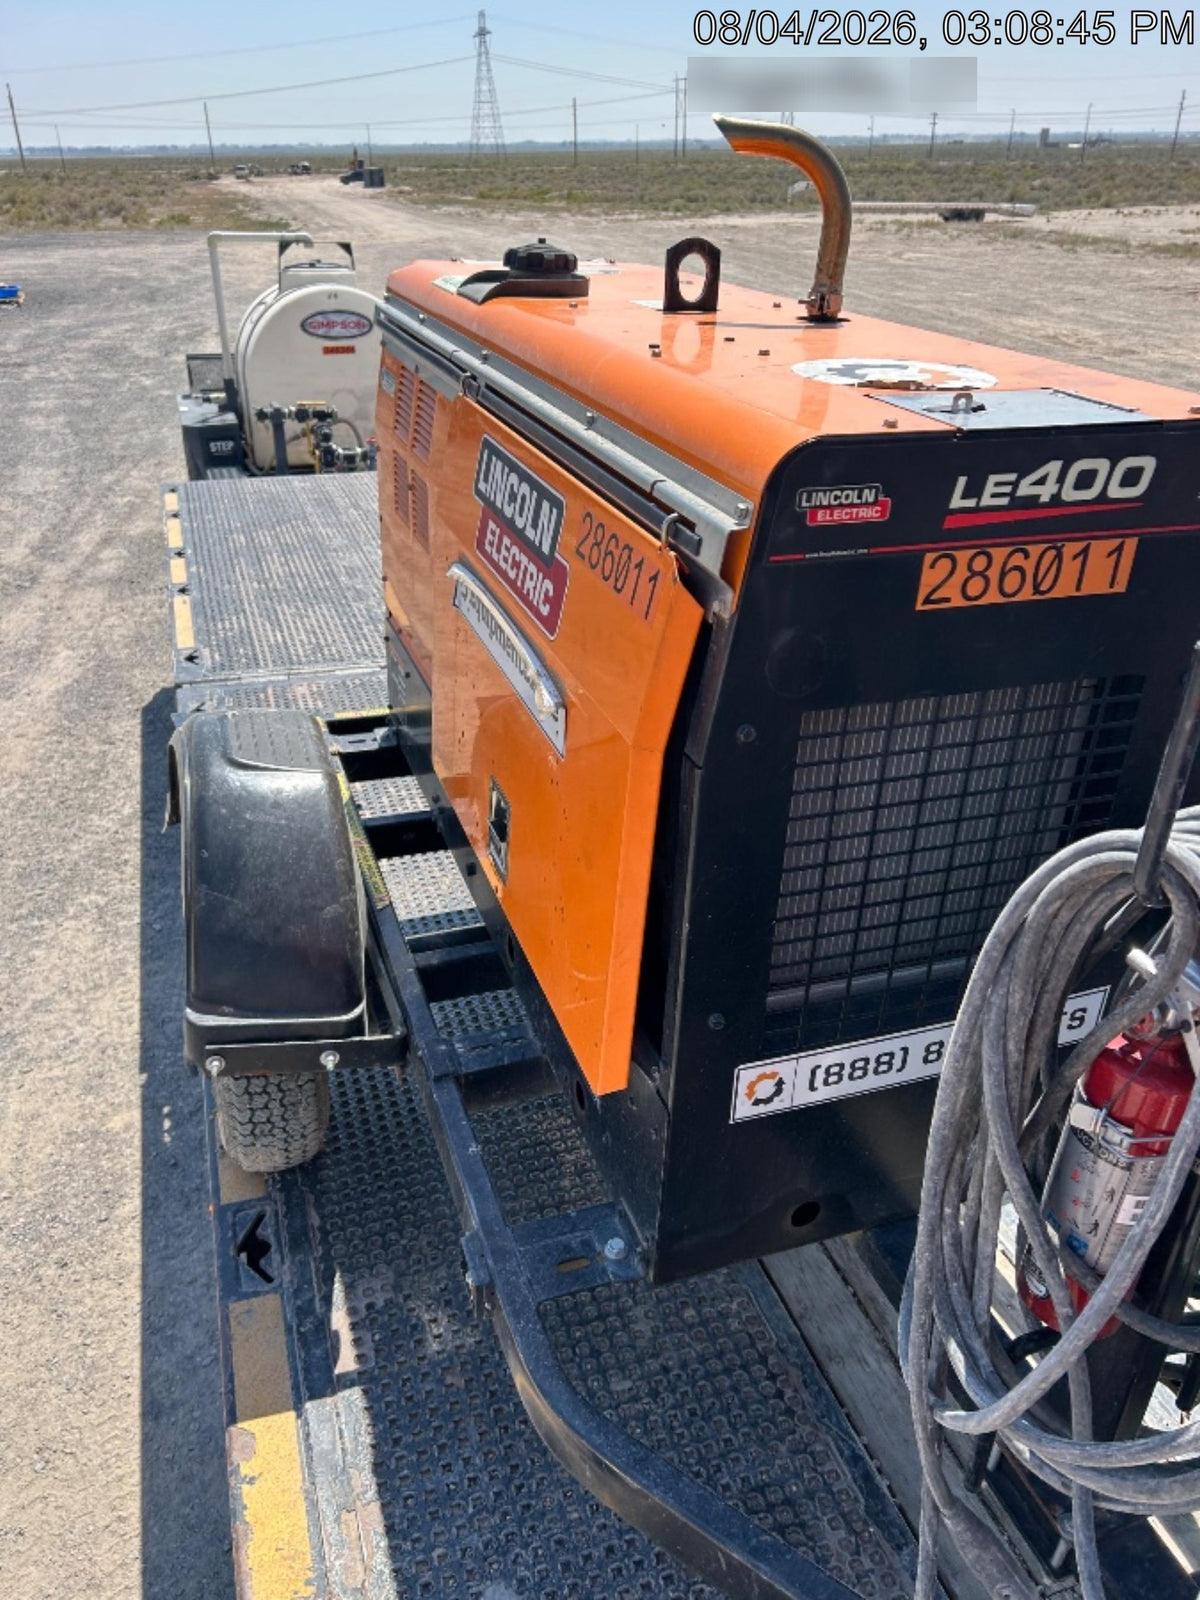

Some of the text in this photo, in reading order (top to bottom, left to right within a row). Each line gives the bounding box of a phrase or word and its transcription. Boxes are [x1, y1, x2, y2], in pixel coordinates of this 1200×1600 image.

[477, 449, 557, 556] LINCOLN
[801, 488, 877, 507] LINCOLN
[948, 454, 1157, 509] LE400
[816, 506, 882, 522] ELECTRIC
[484, 519, 556, 618] ELECTRIC
[574, 511, 661, 620] 286011
[808, 1046, 910, 1092] (888)
